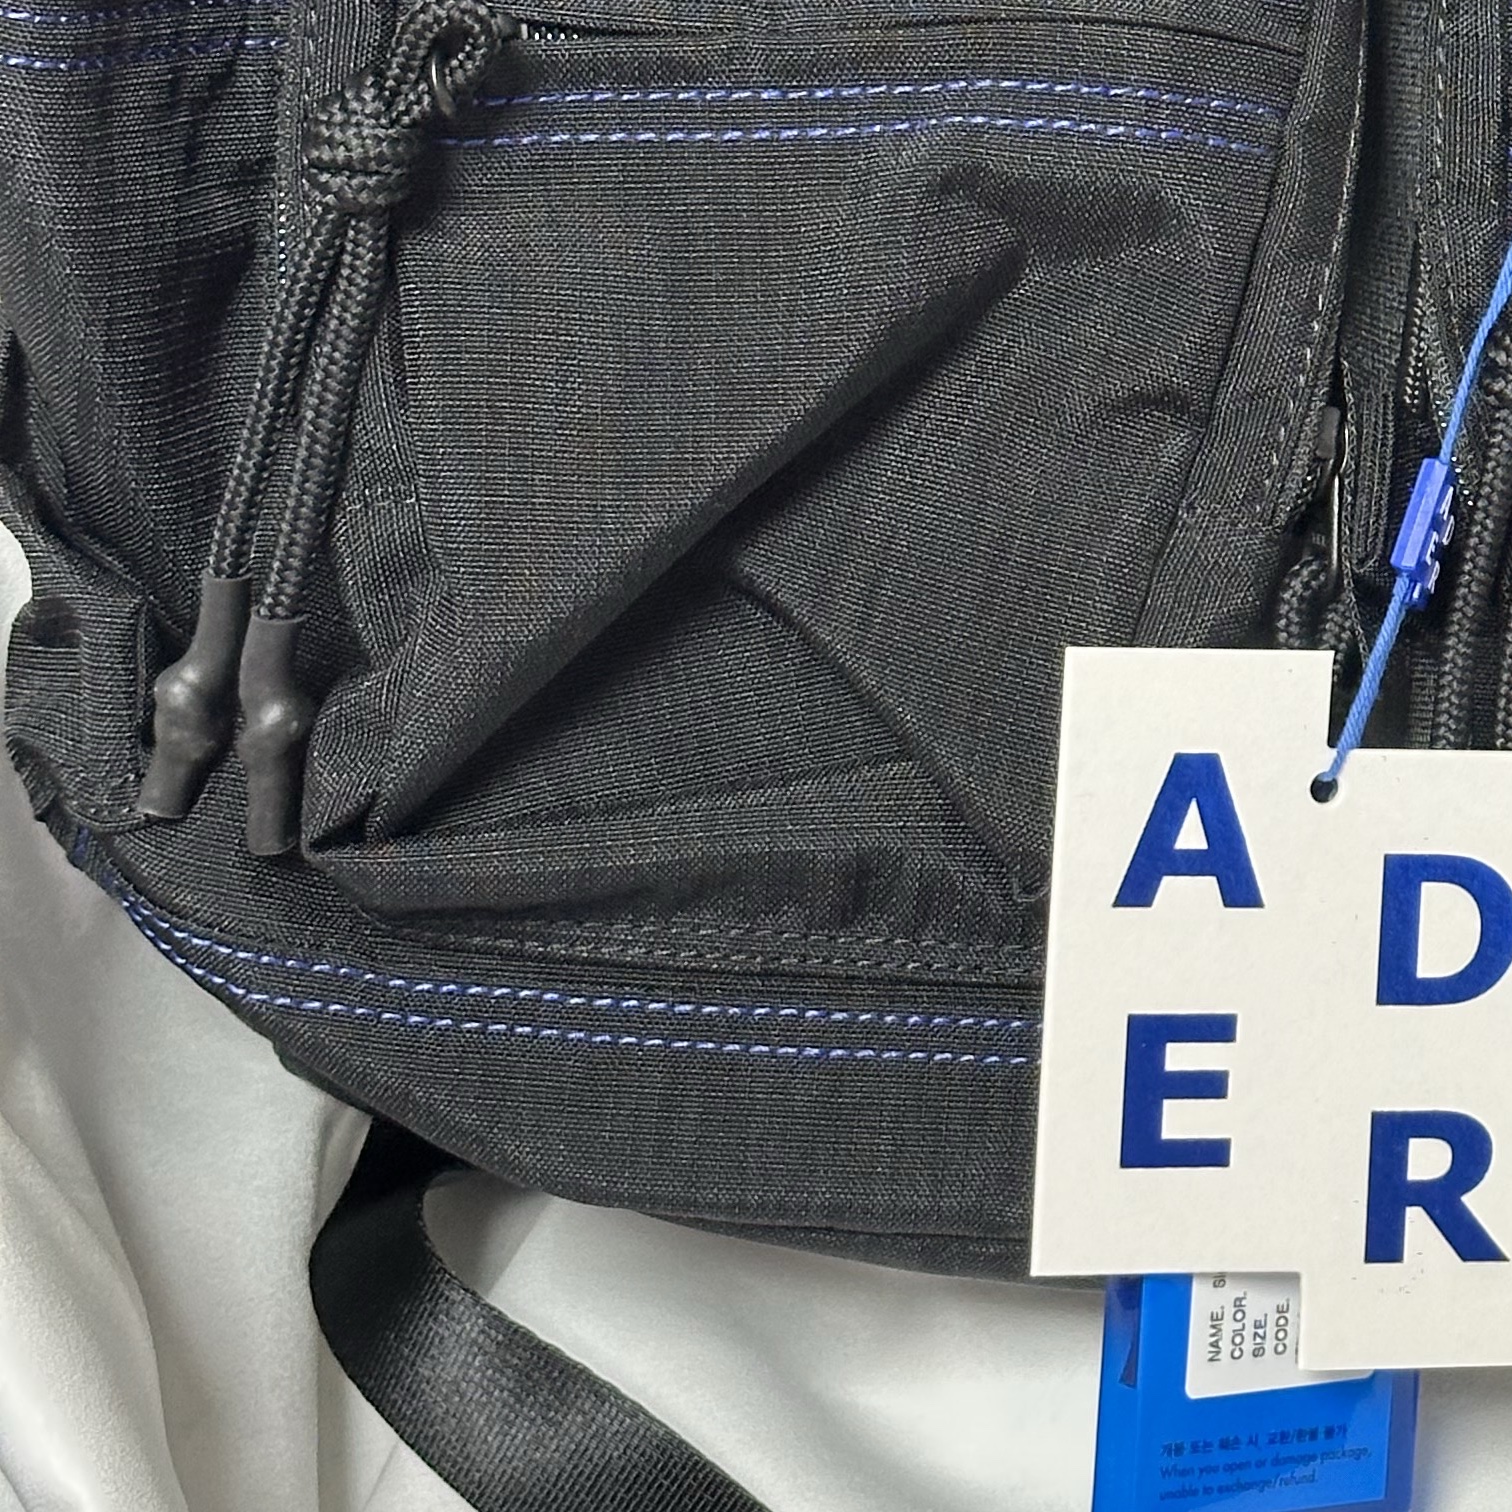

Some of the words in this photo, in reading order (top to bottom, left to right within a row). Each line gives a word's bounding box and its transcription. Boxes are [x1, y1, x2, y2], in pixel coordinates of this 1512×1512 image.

[1207, 1305, 1225, 1362] NAME.
[1230, 1290, 1247, 1360] COLOR.
[1251, 1313, 1268, 1358] SIZE.
[1273, 1297, 1290, 1355] CODE.
[1160, 1464, 1195, 1480] When
[1198, 1465, 1220, 1480] you
[1222, 1460, 1252, 1476] open
[1254, 1458, 1267, 1469] or
[1270, 1451, 1318, 1467] damage
[1160, 1482, 1199, 1500] unable
[1202, 1483, 1215, 1495] to
